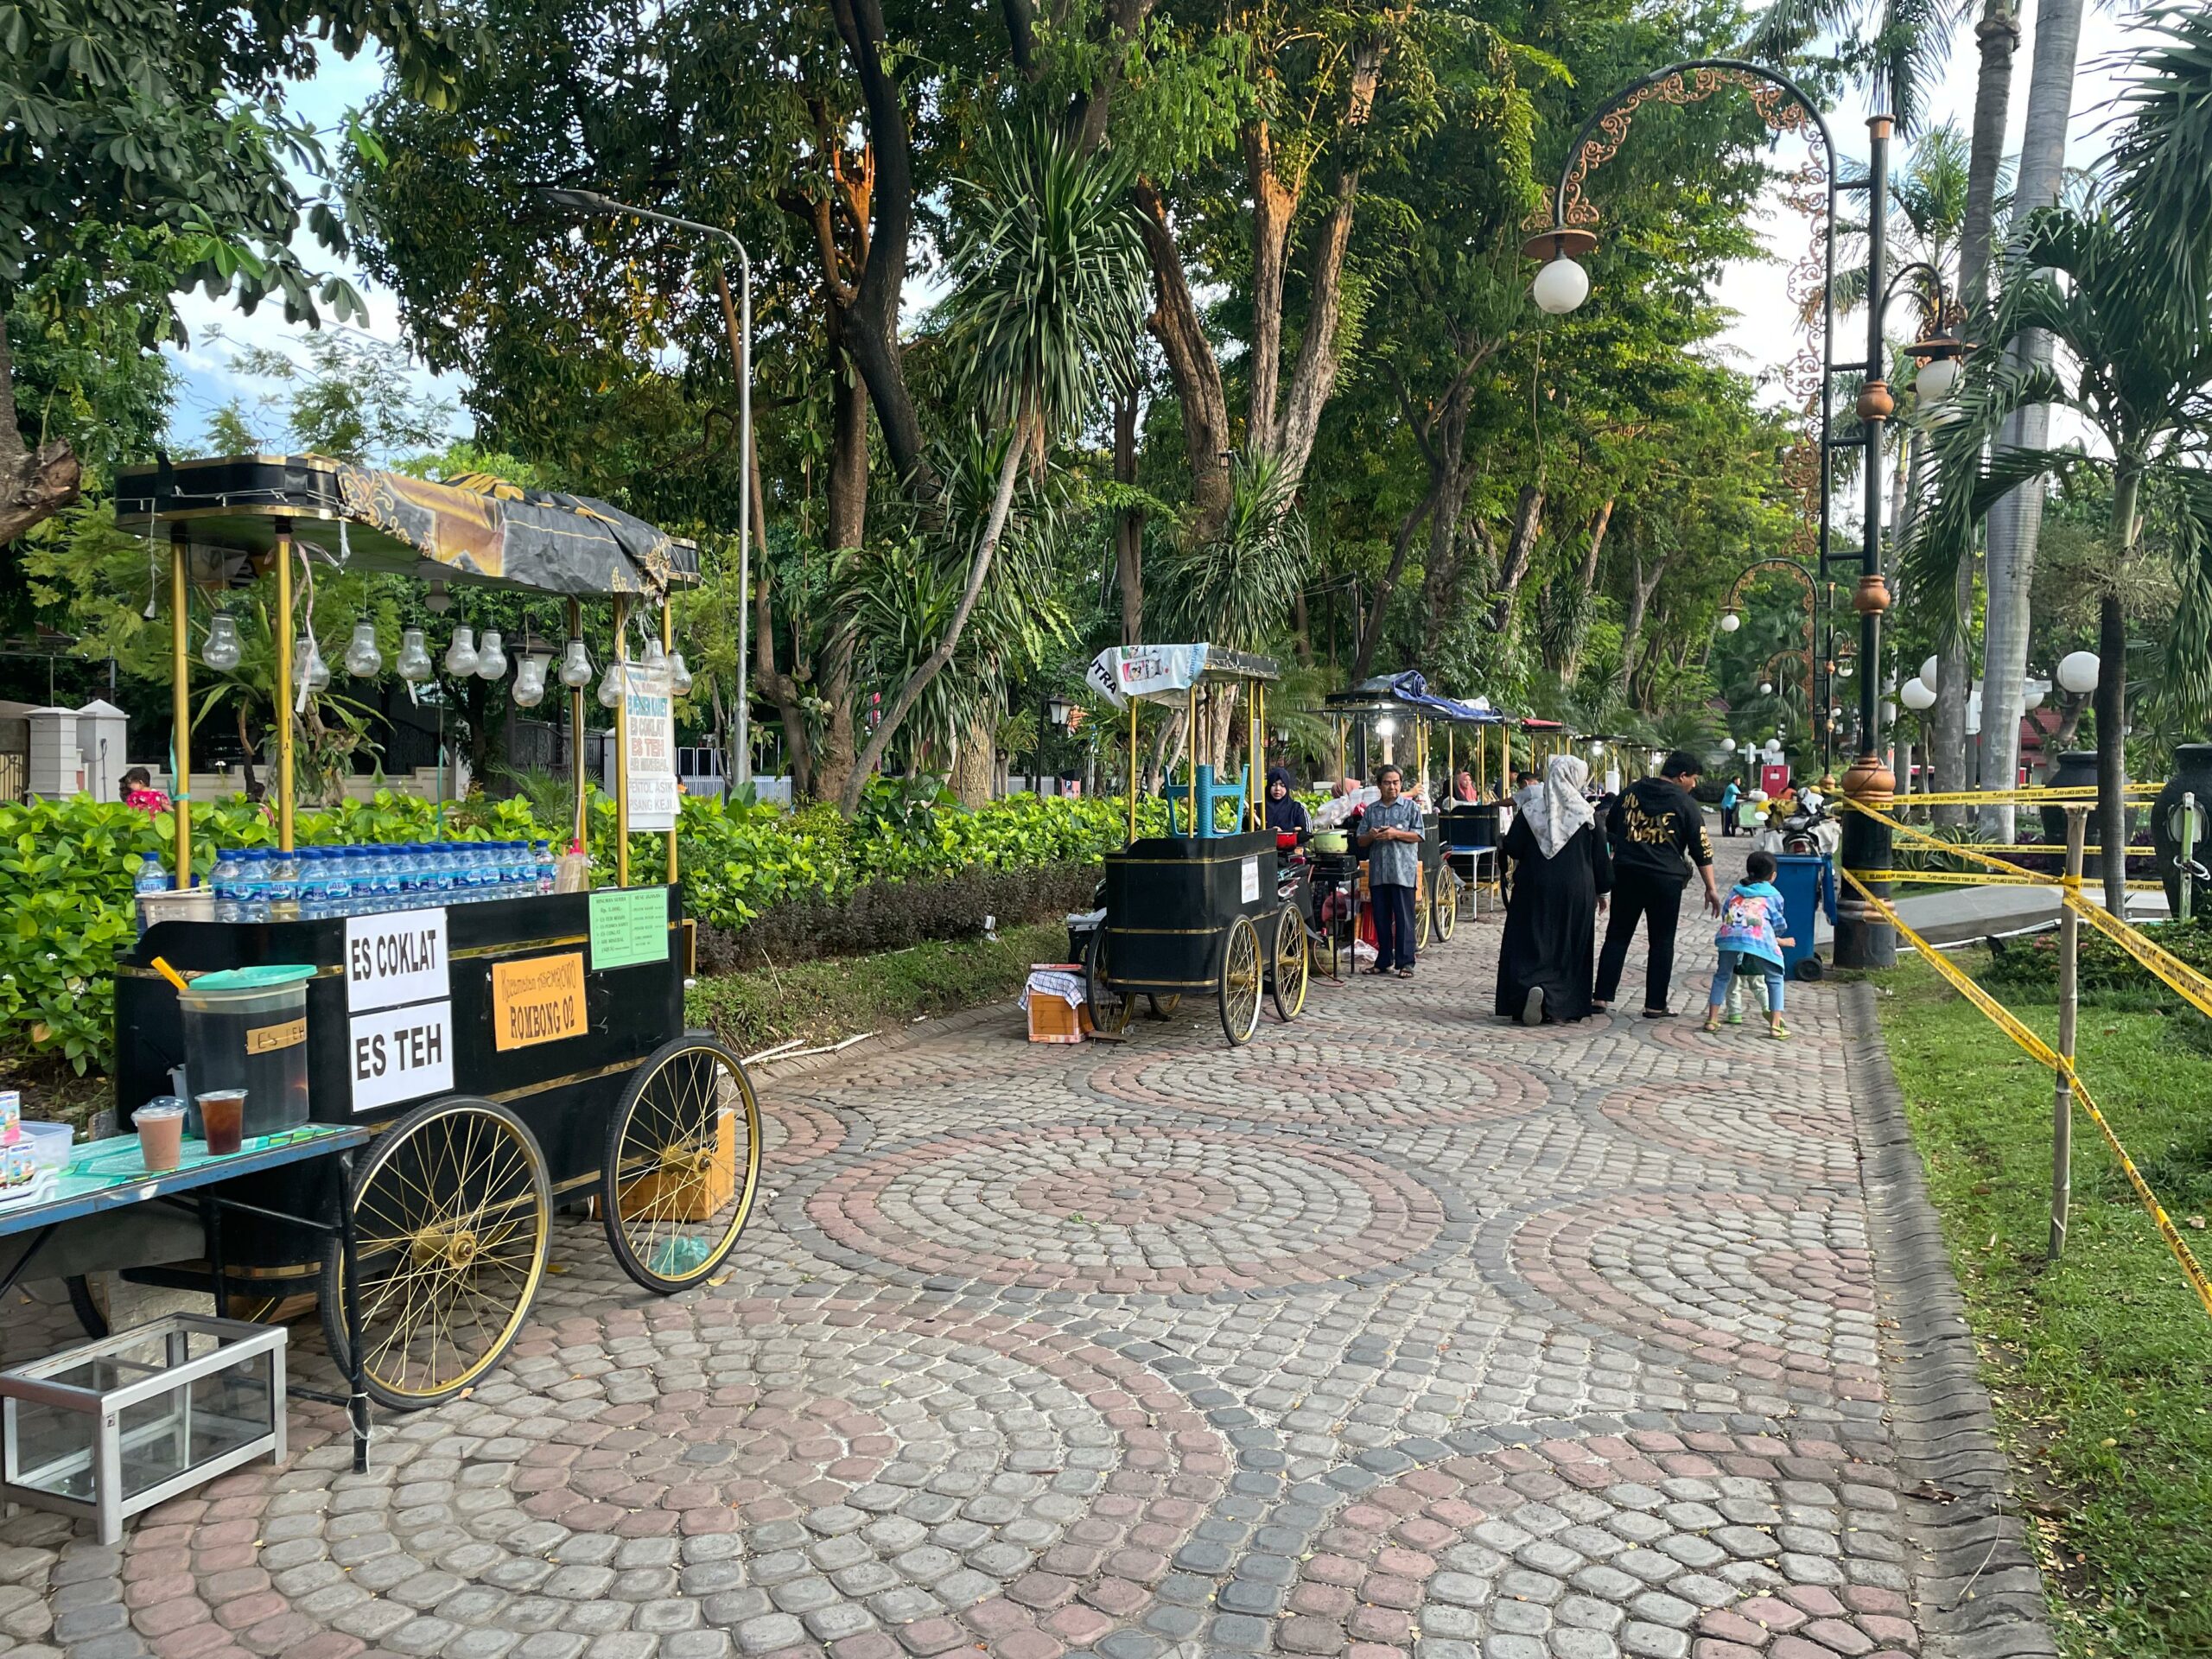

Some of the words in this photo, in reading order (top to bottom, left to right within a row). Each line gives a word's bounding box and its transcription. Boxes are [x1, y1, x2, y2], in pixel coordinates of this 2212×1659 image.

[632, 738, 643, 757] ES
[645, 739, 664, 757] TEH
[655, 781, 673, 793] ASIK
[352, 938, 372, 982] ES
[377, 929, 436, 976] COKLAT
[510, 1001, 560, 1040] ROMBONG
[563, 995, 575, 1030] 02
[286, 1025, 305, 1045] TEH
[356, 1034, 386, 1081] ES
[394, 1023, 442, 1071] TEH
